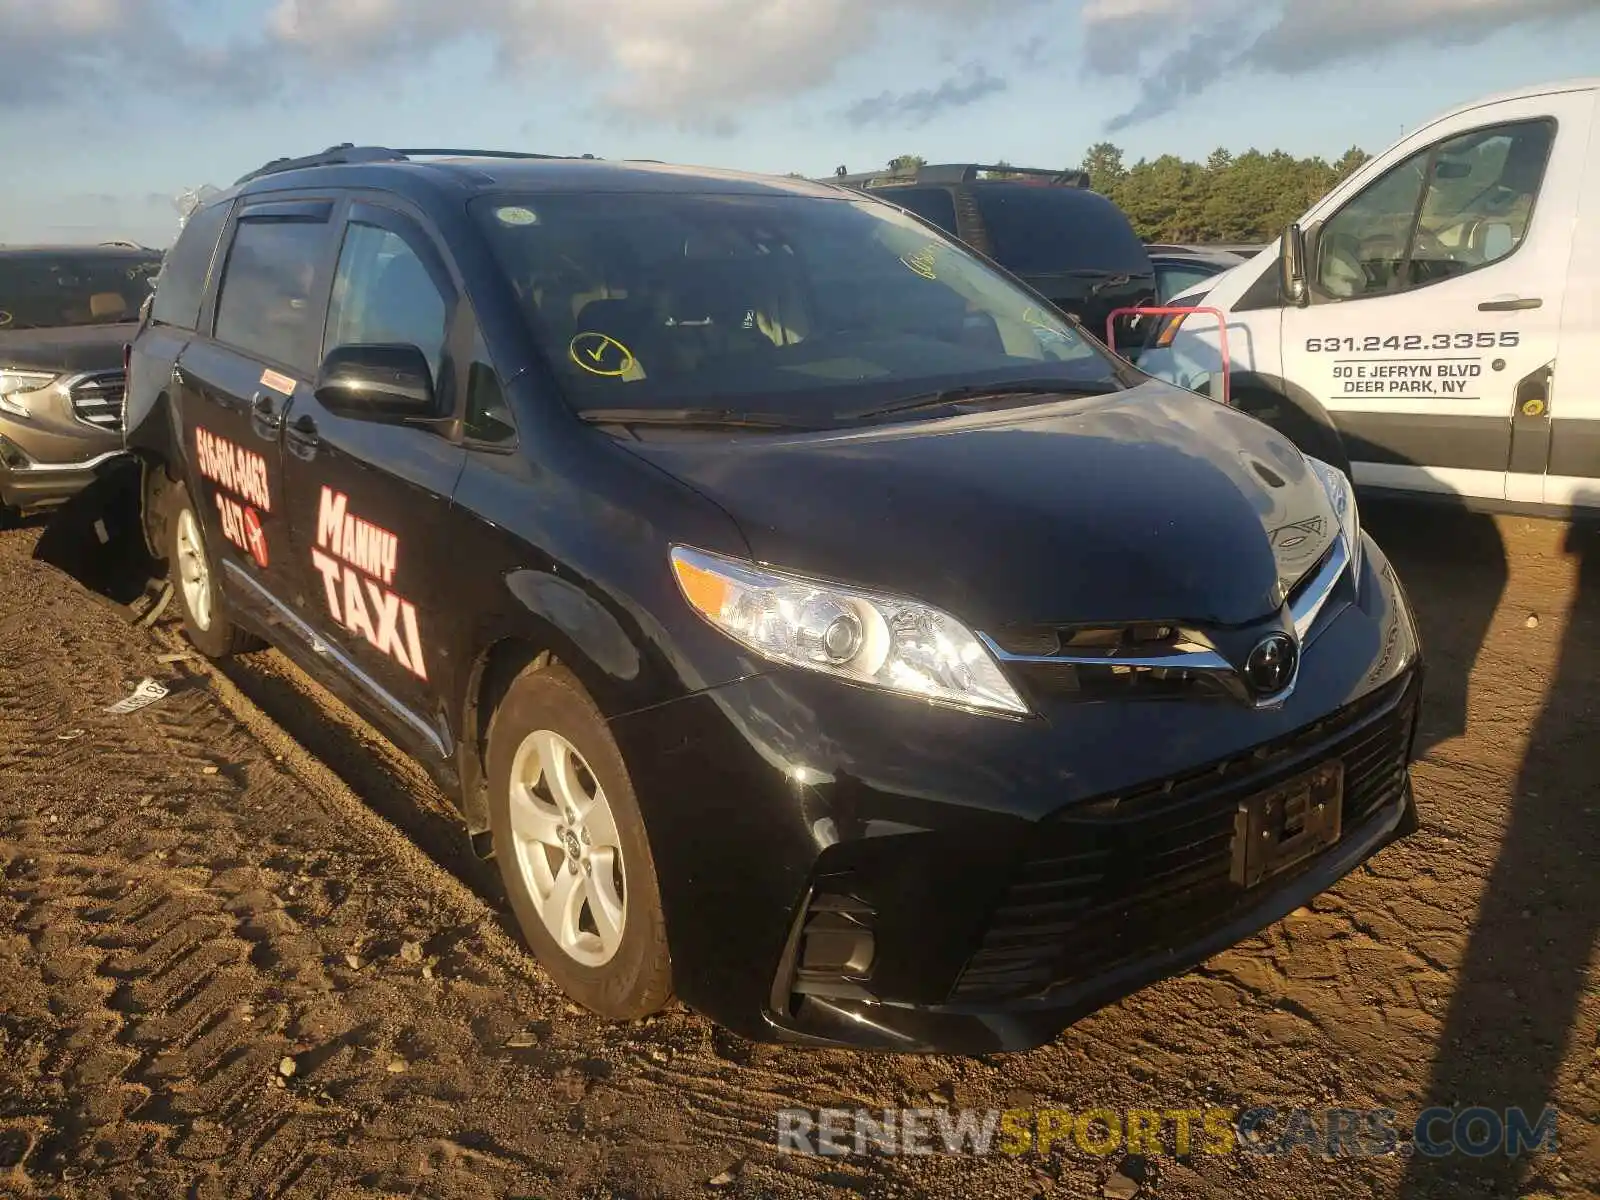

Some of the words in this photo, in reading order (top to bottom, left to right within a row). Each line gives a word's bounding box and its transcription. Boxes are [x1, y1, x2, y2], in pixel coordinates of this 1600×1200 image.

[1306, 332, 1520, 352] 631.242.3355
[1333, 366, 1352, 378] 90
[1357, 366, 1366, 378] E
[1370, 365, 1432, 378] JEFRYN
[1437, 364, 1482, 377] BLVD
[1343, 381, 1384, 393] DEER
[1389, 381, 1437, 394] PARK,
[1442, 380, 1467, 392] NY
[311, 547, 428, 682] TAXI
